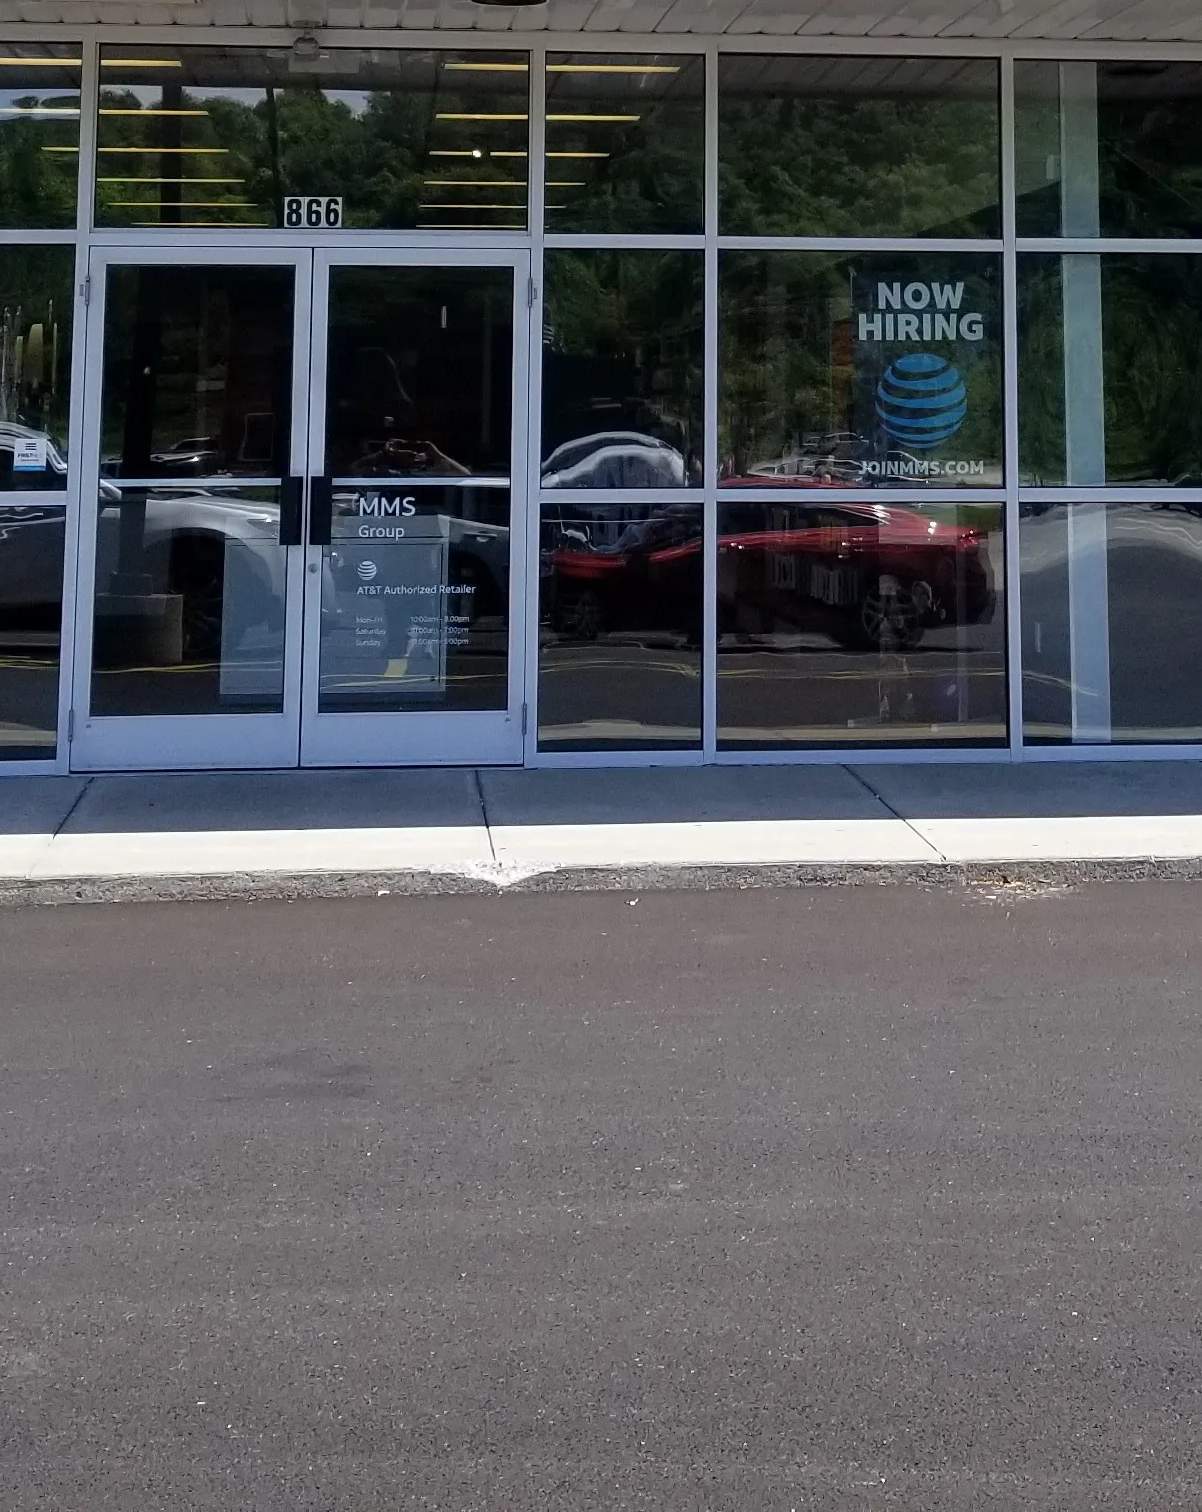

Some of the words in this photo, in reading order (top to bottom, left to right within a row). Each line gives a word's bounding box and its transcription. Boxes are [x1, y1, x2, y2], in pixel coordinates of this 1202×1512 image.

[286, 197, 340, 227] 866
[877, 281, 965, 310] NOW
[858, 312, 984, 341] HIRING
[858, 460, 984, 476] JOINMMS.COM
[359, 496, 416, 517] MMS
[358, 524, 405, 541] Group
[356, 585, 383, 595] AT&T
[384, 584, 437, 595] Authorized
[439, 584, 477, 595] Retailer
